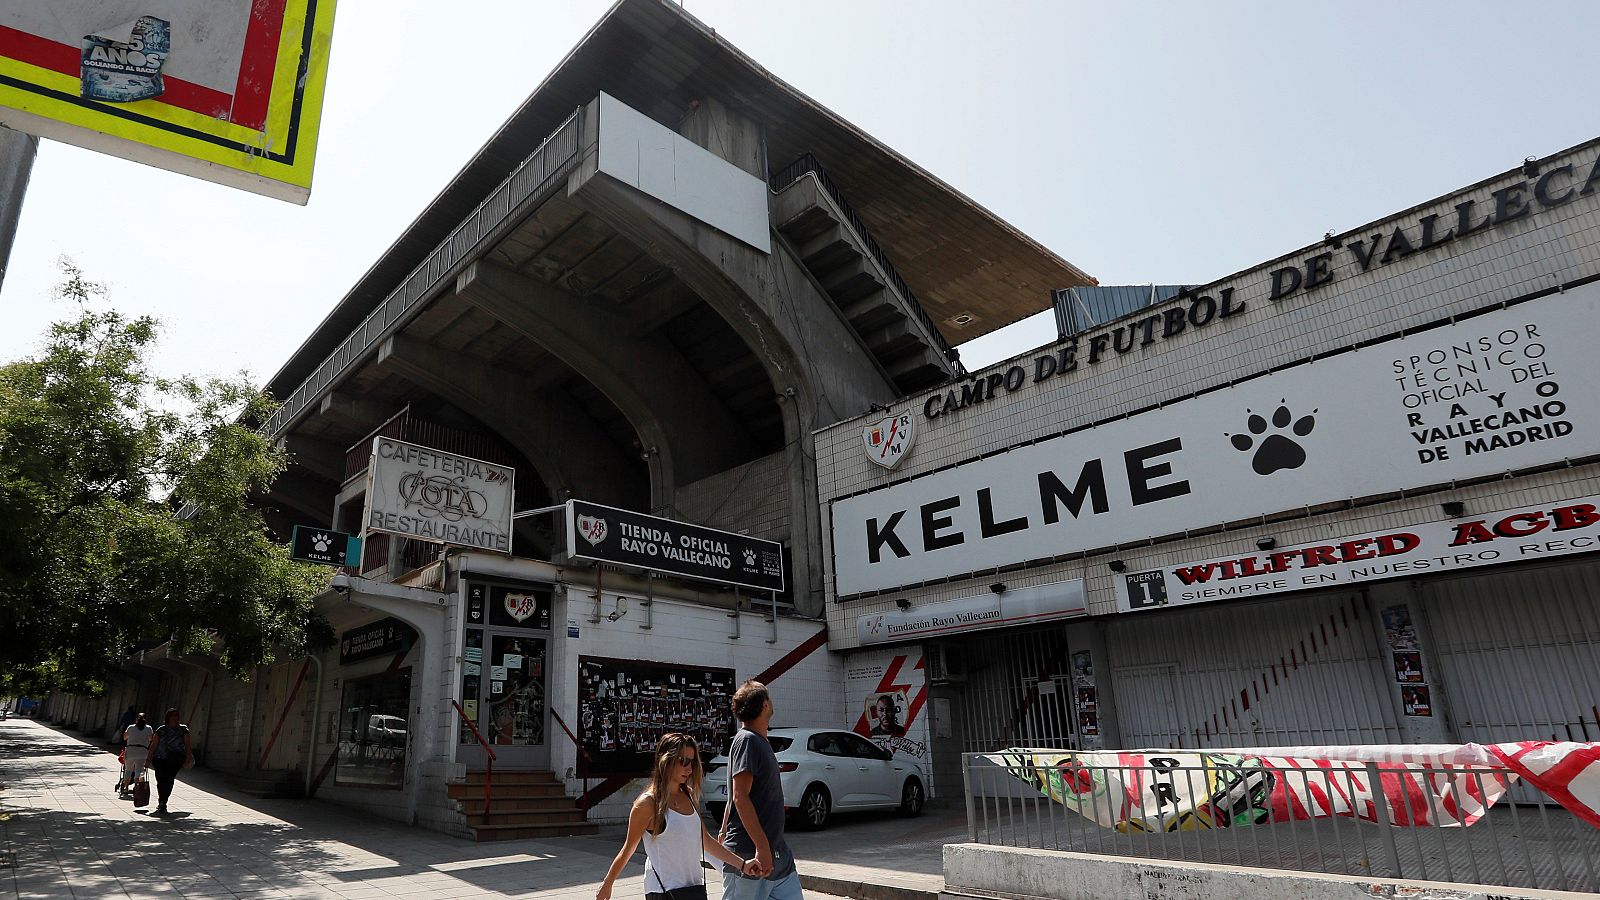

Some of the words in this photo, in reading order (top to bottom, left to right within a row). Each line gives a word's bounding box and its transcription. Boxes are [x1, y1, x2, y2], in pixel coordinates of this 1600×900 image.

[84, 60, 124, 70] GOLEANDO
[924, 366, 1025, 419] CAMPO
[1033, 345, 1078, 383] DE
[1088, 286, 1246, 364] FUTBOL
[1269, 252, 1335, 301] DE
[1393, 324, 1541, 374] SPONSOR
[1396, 343, 1546, 391] TÉCNICO
[1402, 378, 1489, 408] OFICIAL
[1511, 362, 1555, 384] DEL
[898, 429, 907, 440] V
[900, 415, 910, 427] R
[1411, 400, 1566, 445] VALLECANO
[377, 442, 483, 480] CAFETERIA
[890, 443, 902, 456] M
[1417, 446, 1450, 464] DE
[1464, 420, 1574, 456] MADRID
[865, 437, 1191, 564] KELME
[371, 511, 508, 551] RESTAURANTE
[619, 522, 673, 545] TIENDA
[680, 535, 730, 555] OFICIAL
[308, 553, 332, 561] KELME
[621, 537, 658, 556] RAYO
[661, 545, 731, 569] VALLECANO
[1172, 533, 1421, 586] WILFRED
[1181, 579, 1288, 601] SIEMPRE
[1302, 572, 1337, 585] EN
[1351, 550, 1500, 579] NUESTRO
[1520, 535, 1600, 555] REC
[1127, 572, 1162, 584] PUERTA
[1140, 582, 1154, 604] 1
[887, 618, 931, 634] Fundación
[932, 616, 954, 628] Rayo
[956, 609, 1000, 624] Vallecano
